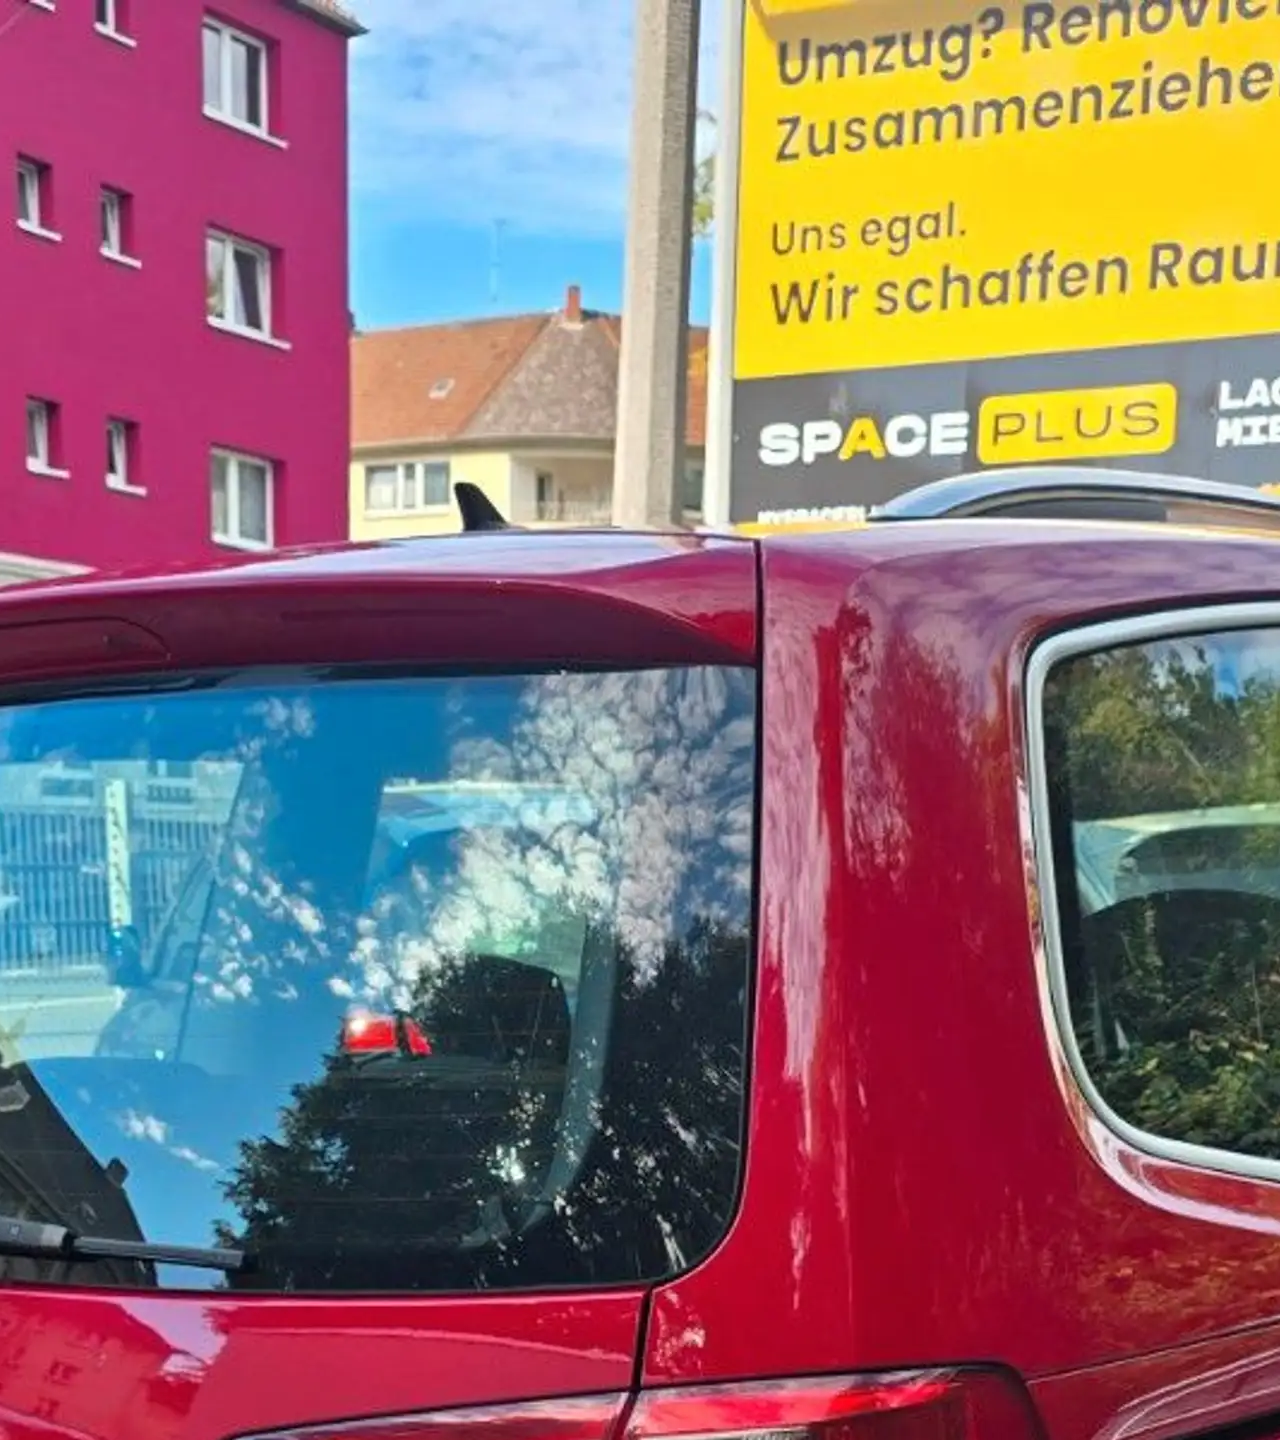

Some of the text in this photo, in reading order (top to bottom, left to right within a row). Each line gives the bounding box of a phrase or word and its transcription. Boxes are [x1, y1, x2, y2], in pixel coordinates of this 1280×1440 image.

[778, 8, 1005, 85] Umzug?
[771, 200, 967, 257] Uns egal.
[770, 271, 859, 325] Wir
[875, 249, 1129, 316] schaffen
[757, 400, 1161, 467] SPACE PLUS
